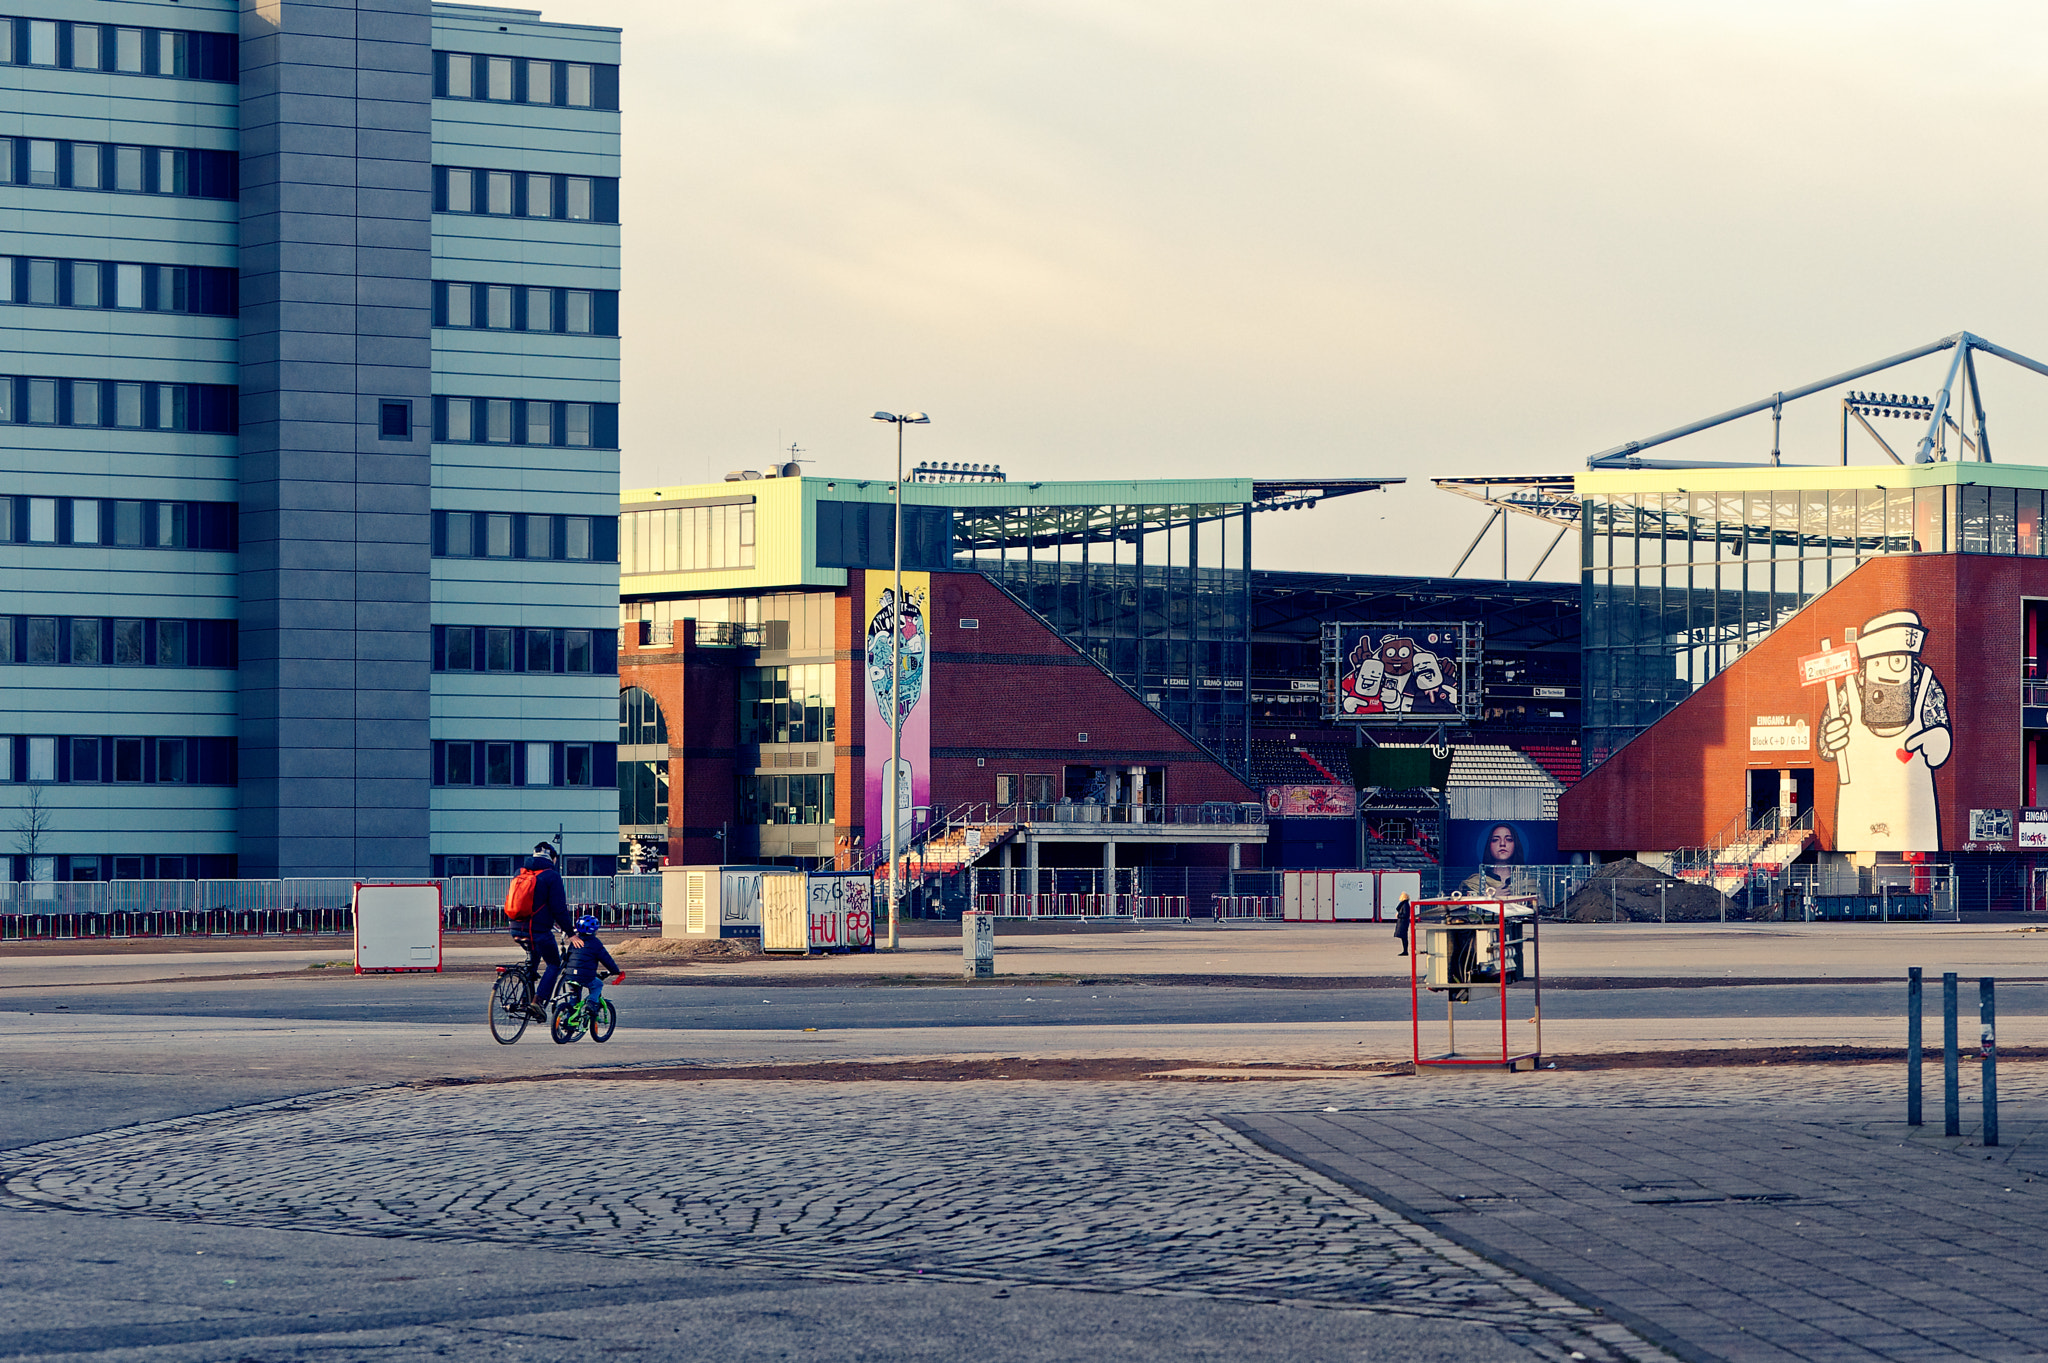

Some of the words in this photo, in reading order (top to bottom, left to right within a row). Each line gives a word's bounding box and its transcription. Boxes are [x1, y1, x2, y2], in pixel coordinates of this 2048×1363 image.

[873, 616, 895, 633] ALON
[1756, 715, 1785, 726] EINGANG
[1785, 715, 1791, 725] 4
[1752, 736, 1768, 746] Block
